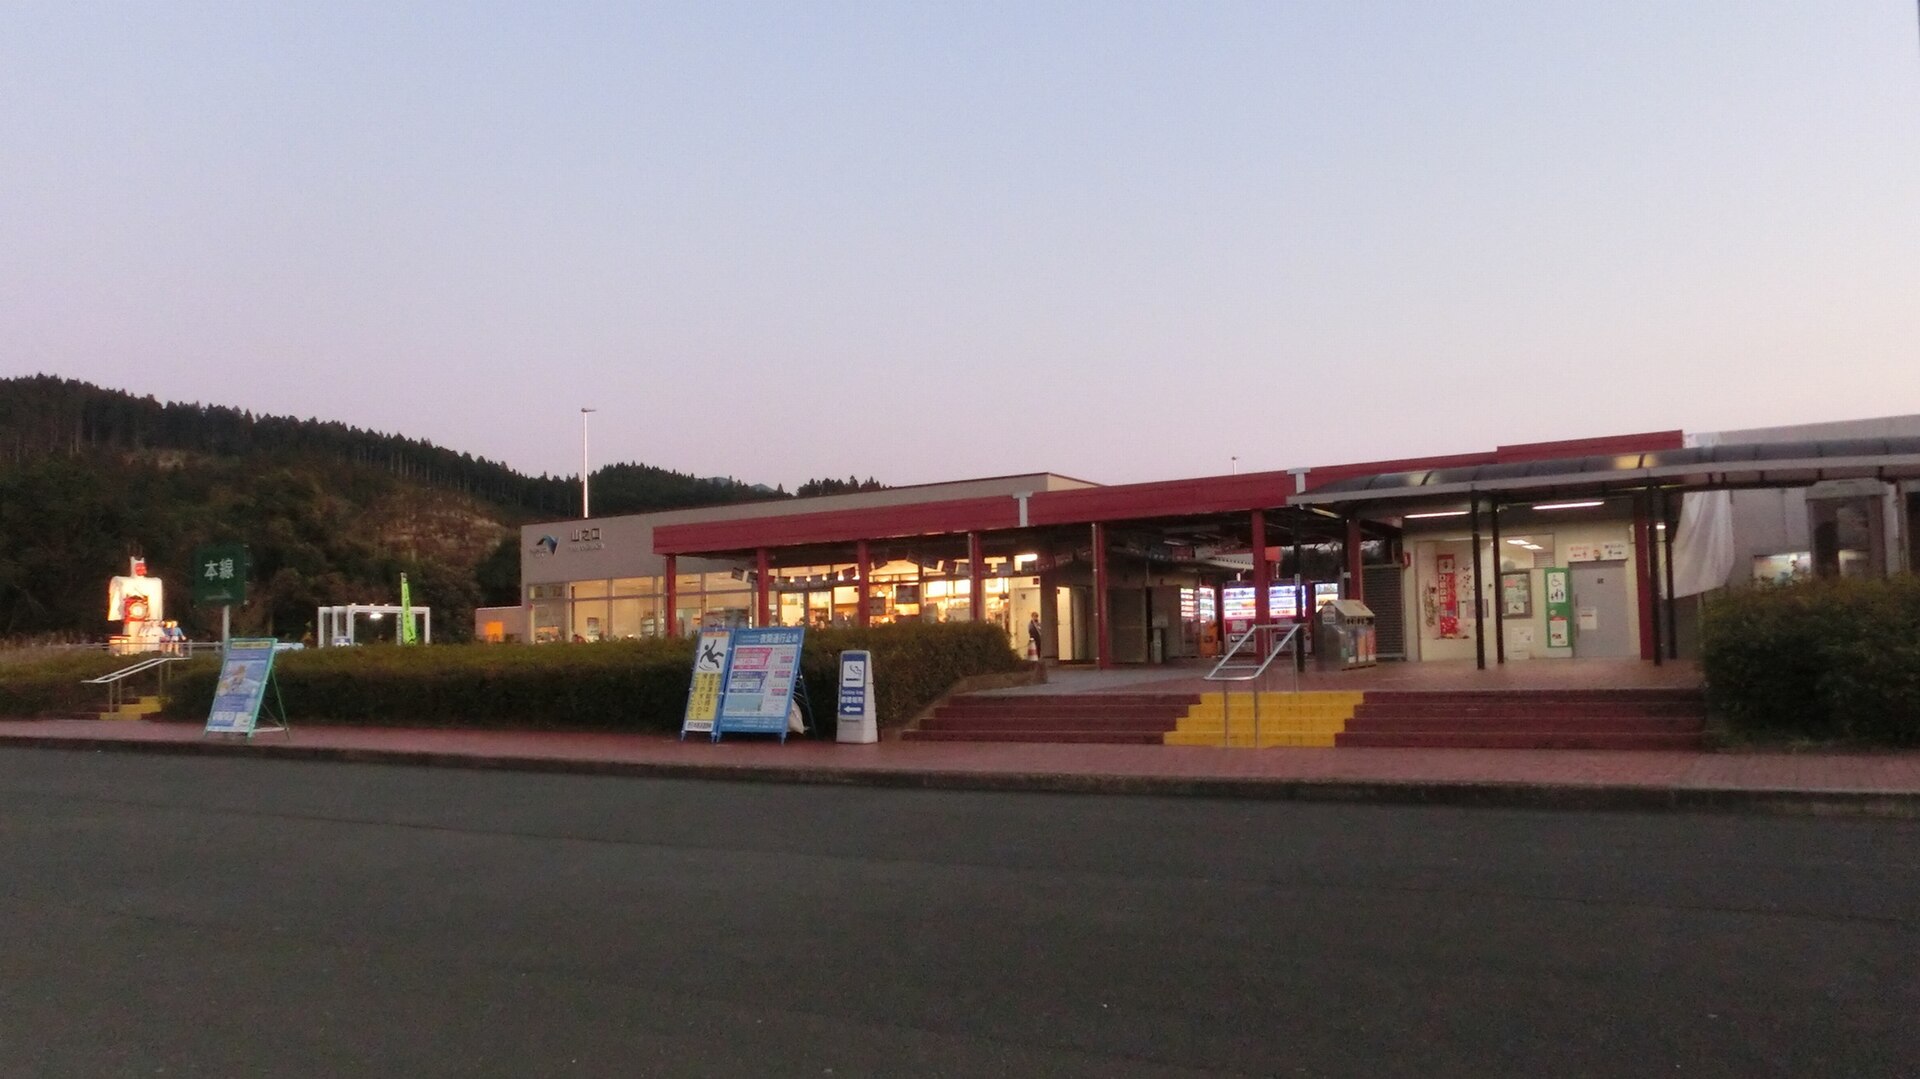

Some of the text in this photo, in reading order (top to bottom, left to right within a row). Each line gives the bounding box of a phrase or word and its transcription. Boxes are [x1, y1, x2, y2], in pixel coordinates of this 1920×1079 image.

[571, 527, 602, 542] 山之口
[204, 558, 234, 581] 本線
